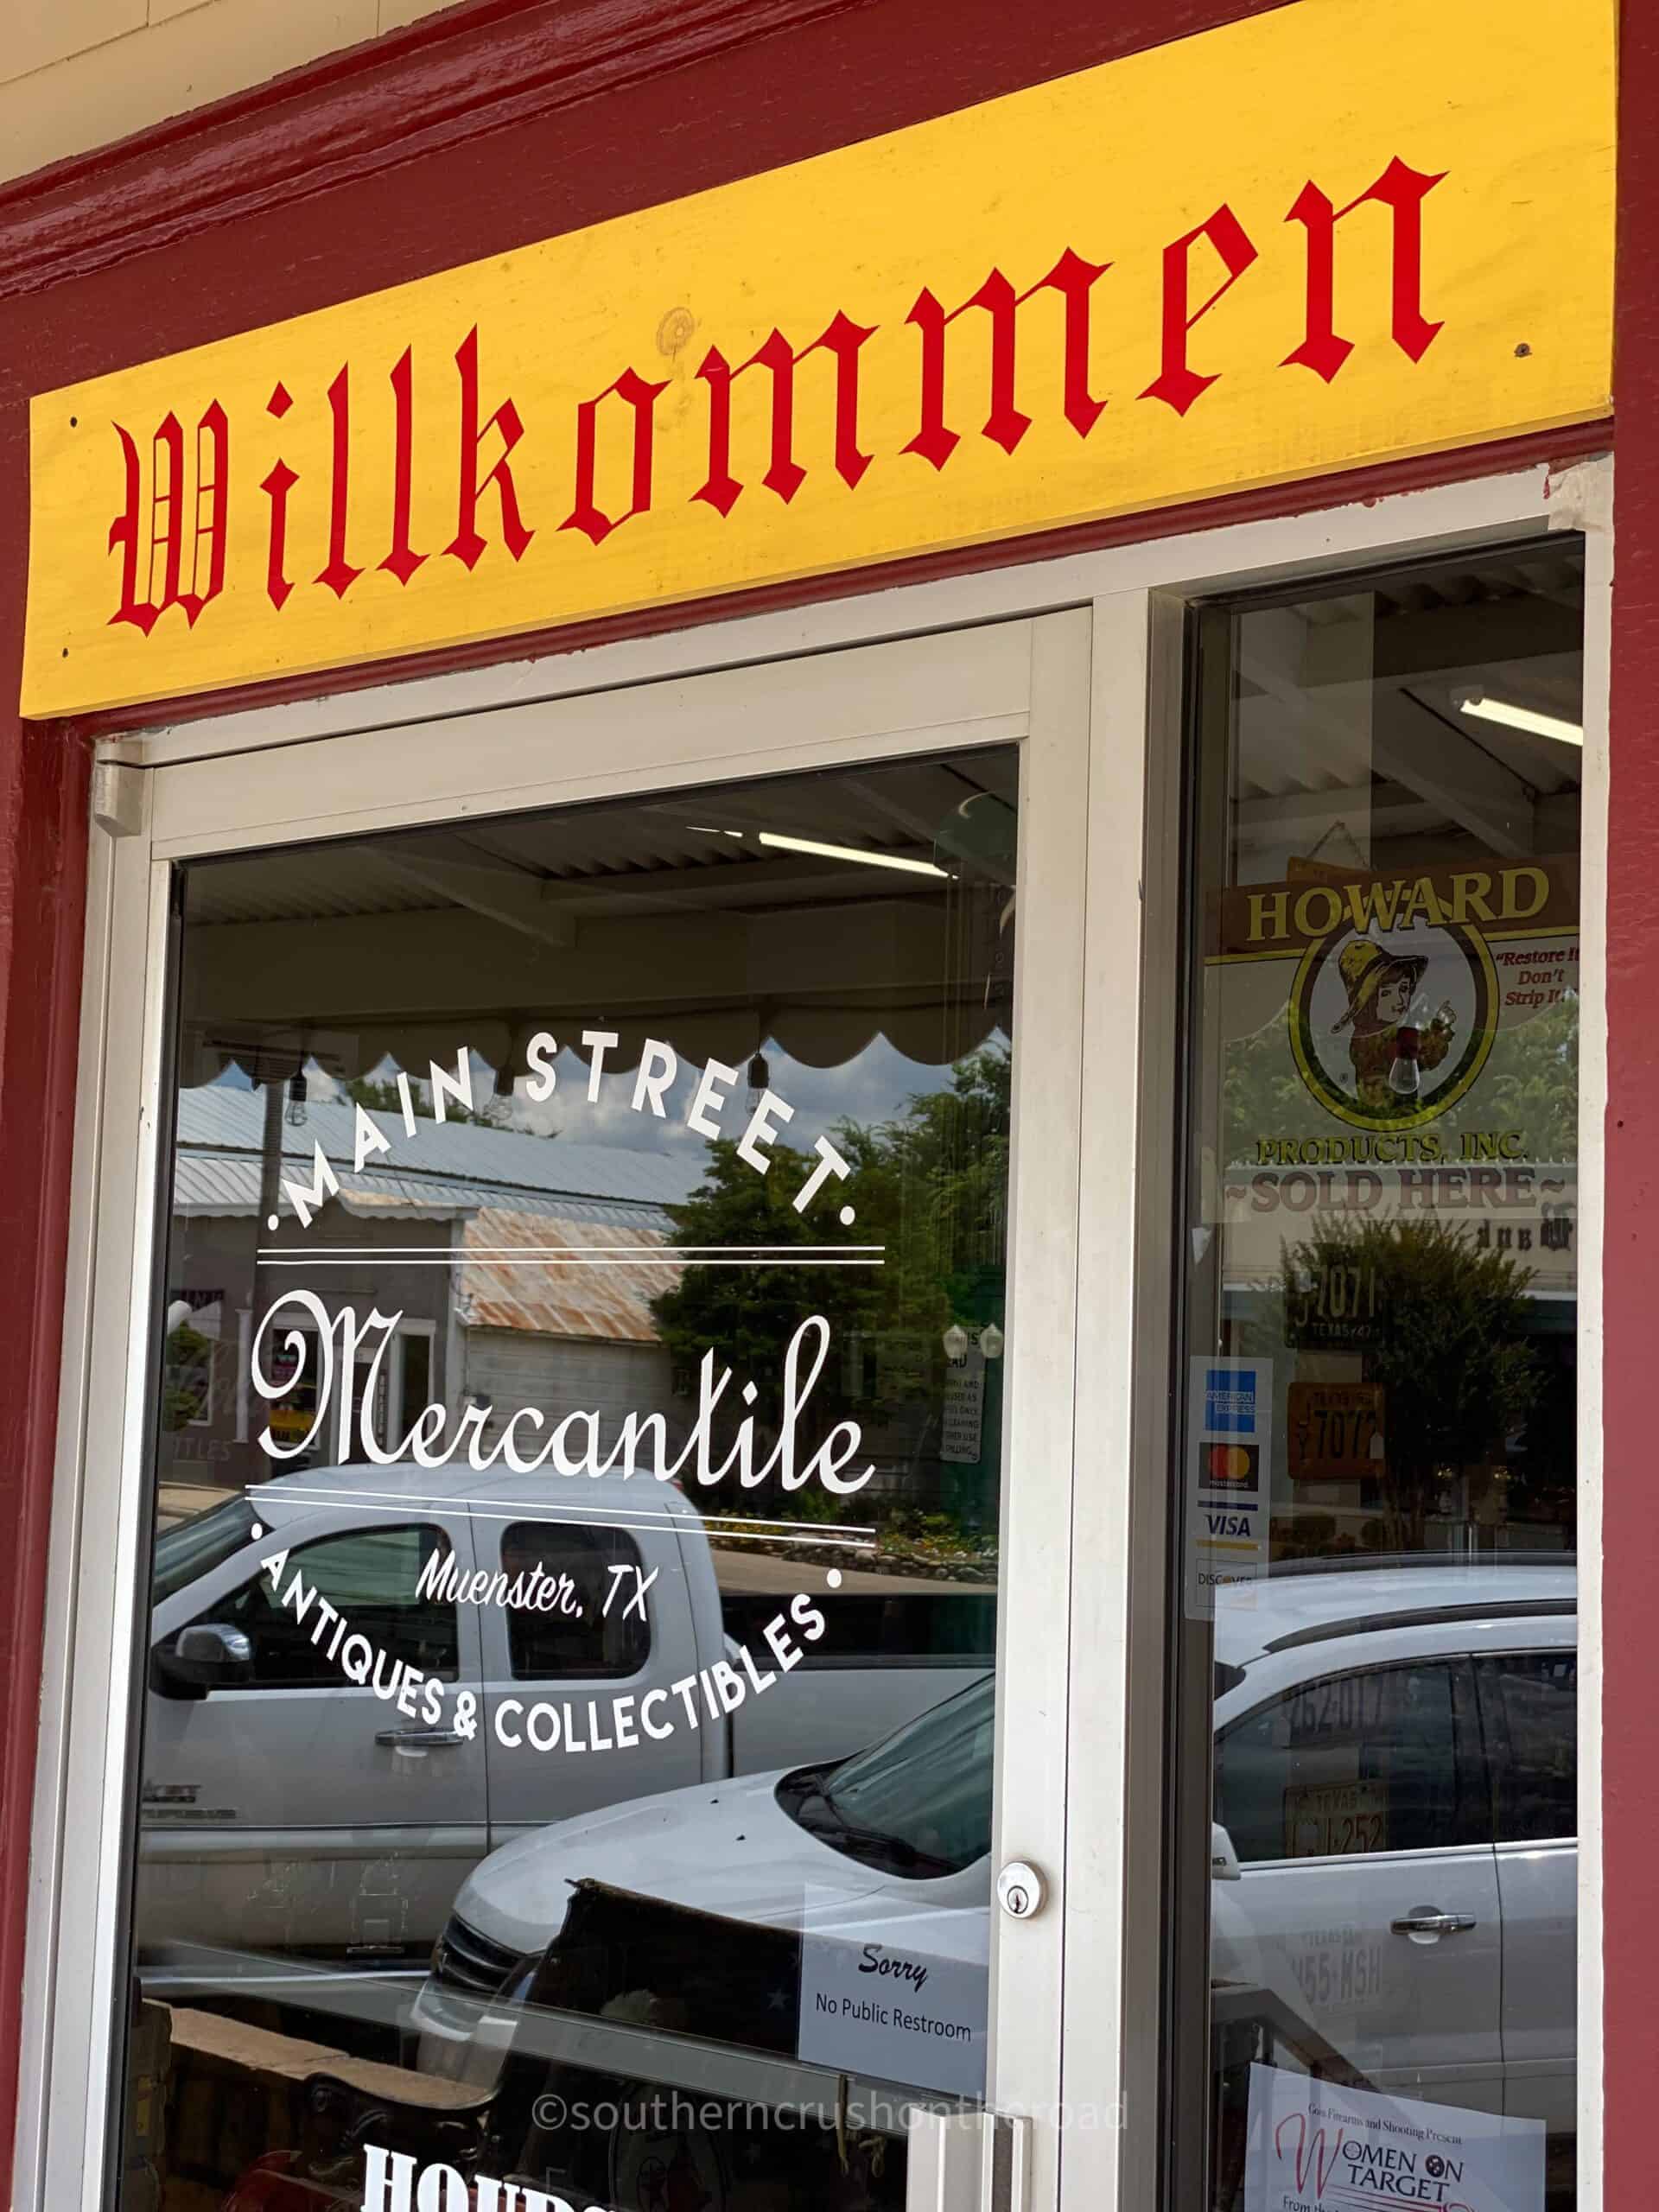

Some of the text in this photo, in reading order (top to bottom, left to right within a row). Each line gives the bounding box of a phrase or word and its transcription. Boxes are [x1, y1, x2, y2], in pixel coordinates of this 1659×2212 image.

[109, 156, 1446, 637] Willkommen
[1245, 867, 1550, 942] HOWARD
[1505, 989, 1545, 1009] Strip
[1518, 969, 1564, 984] Don't
[281, 1030, 851, 1229] MAIN STREET
[1256, 1130, 1529, 1166] PRODUCTS, INC.
[252, 1289, 876, 1495] Mercantile
[1205, 1514, 1251, 1537] VISA
[415, 1548, 659, 1621] Muenster, TX
[259, 1548, 825, 1752] ANTIQUES & COLLECTIBLES
[858, 1942, 928, 1993] Sorry
[816, 1993, 972, 2043] No Public Restroom
[1274, 2113, 1465, 2200] WOMEN ON
[1366, 2118, 1382, 2132] and
[1383, 2119, 1425, 2140] Shooting
[360, 2143, 615, 2212] HOU
[1347, 2162, 1451, 2202] TARGET
